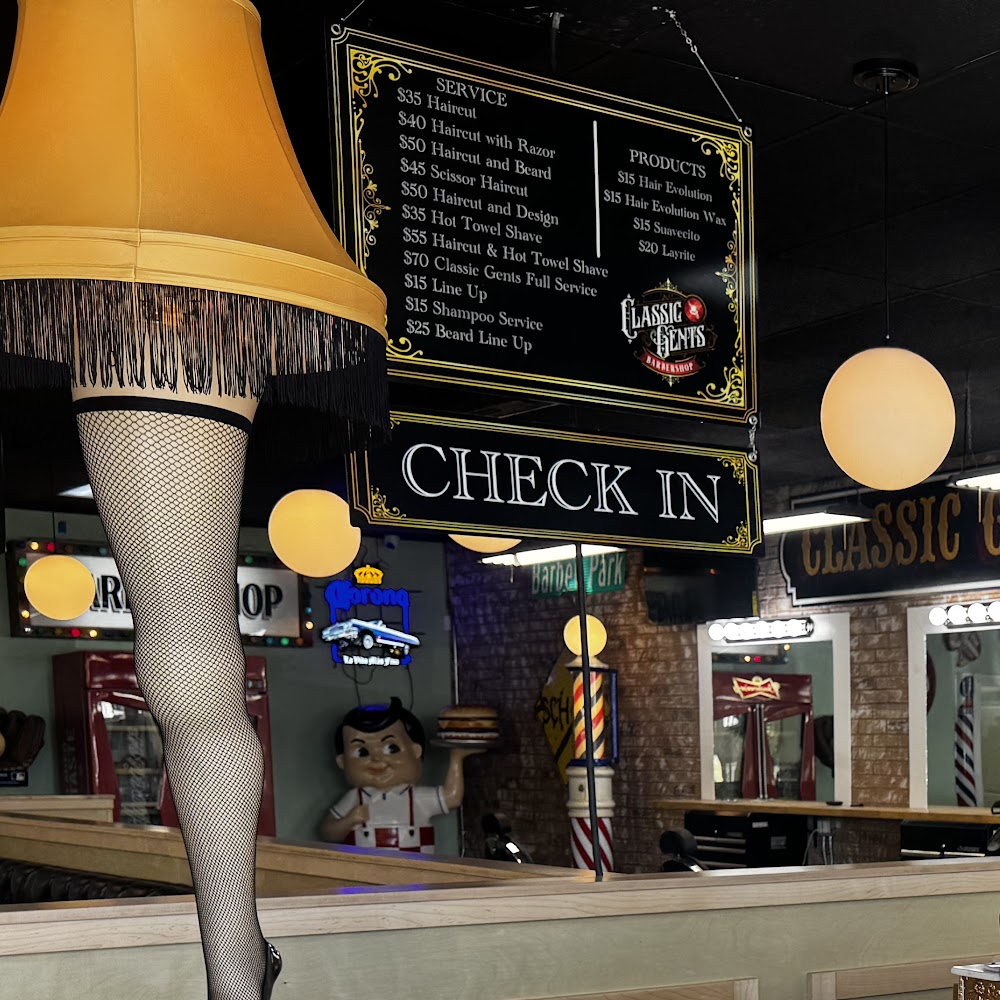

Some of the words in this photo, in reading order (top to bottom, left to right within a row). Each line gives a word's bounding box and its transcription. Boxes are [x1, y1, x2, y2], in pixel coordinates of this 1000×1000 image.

[397, 87, 422, 105] $35
[427, 94, 477, 119] Haircut
[436, 77, 508, 107] SERVICE
[398, 111, 426, 129] $40
[431, 118, 481, 142] Haircut
[485, 134, 513, 150] with
[517, 137, 556, 159] Razor
[399, 134, 426, 152] $50
[431, 141, 481, 165] Haircut
[486, 157, 510, 172] and
[514, 159, 552, 180] Beard
[629, 148, 707, 179] PRODUCTS
[400, 157, 426, 176] $45
[430, 164, 476, 187] Scissor
[480, 174, 528, 198] Haircut
[617, 170, 636, 186] $15
[638, 175, 663, 191] Hair
[665, 181, 713, 203] Evolution
[401, 181, 428, 199] $50
[433, 187, 482, 211] Haircut
[487, 203, 511, 217] and
[516, 203, 559, 228] Design
[603, 189, 621, 204] $15
[625, 193, 649, 210] Hair
[652, 199, 700, 221] Evolution
[702, 210, 727, 227] Wax
[401, 204, 426, 222] $35
[431, 209, 456, 228] Hot
[461, 215, 501, 236] Towel
[505, 224, 543, 244] Shave
[633, 216, 651, 232] $15
[653, 221, 701, 242] Suavecito
[402, 227, 427, 245] $55
[432, 232, 481, 256] Haircut
[487, 243, 498, 258] &
[503, 245, 527, 264] Hot
[530, 250, 570, 271] Towel
[572, 258, 609, 278] Shave
[638, 239, 659, 255] $20
[661, 244, 696, 262] Layrite
[403, 250, 429, 268] $70
[434, 256, 480, 277] Classic
[483, 264, 521, 284] Gents
[525, 271, 551, 290] Full
[554, 277, 598, 297] Service
[404, 273, 427, 291] $15
[432, 277, 463, 297] Line
[466, 283, 488, 304] Up
[405, 296, 428, 313] $15
[432, 300, 495, 325] Shampoo
[499, 311, 544, 331] Service
[620, 295, 682, 342] CLASSIC
[406, 319, 430, 336] $25
[435, 323, 474, 343] Beard
[478, 329, 508, 348] Line
[512, 335, 533, 355] Up
[650, 324, 706, 359] GENTS
[646, 354, 694, 374] BARBERSHOP
[402, 443, 638, 516] CHECK
[656, 469, 721, 524] IN
[802, 493, 960, 577] CLASSIC
[589, 552, 624, 592] Park
[237, 583, 284, 619] OP
[541, 697, 571, 728] SCH
